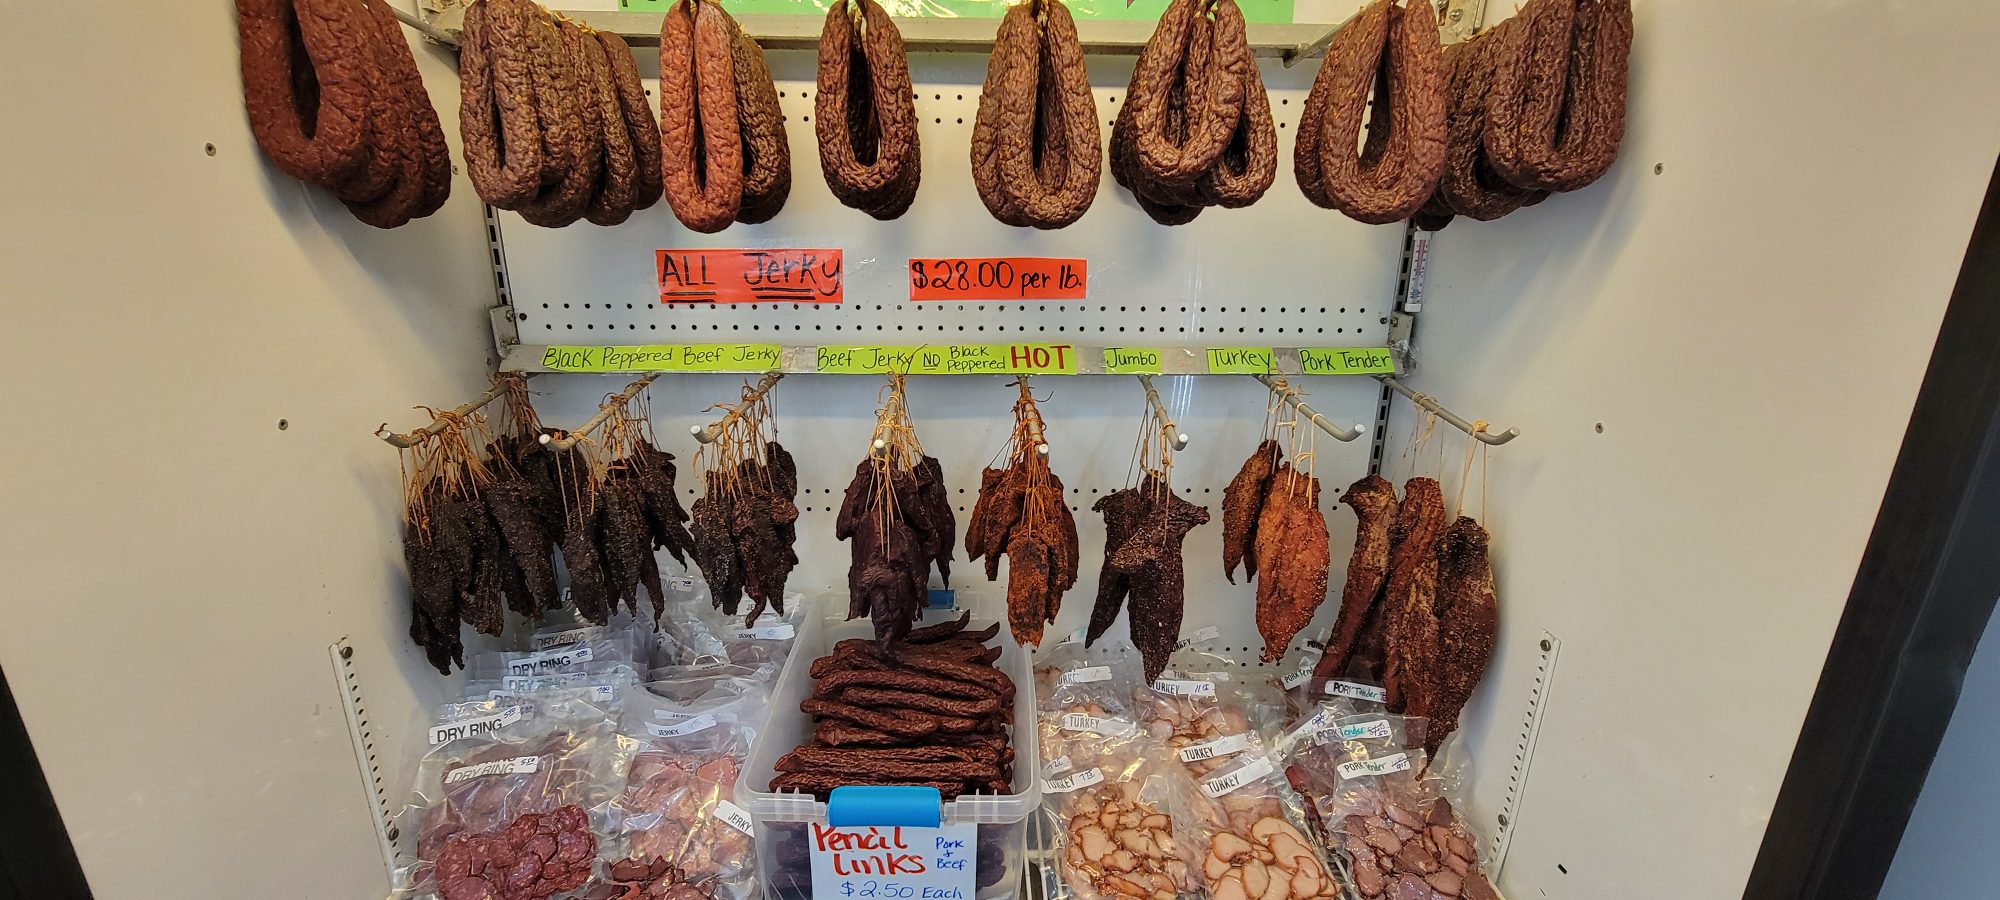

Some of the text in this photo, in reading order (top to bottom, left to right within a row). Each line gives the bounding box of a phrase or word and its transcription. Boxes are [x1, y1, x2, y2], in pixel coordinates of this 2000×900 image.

[661, 253, 715, 288] ALL
[911, 260, 1014, 291] $28.00
[1020, 271, 1051, 298] per
[542, 345, 781, 369] Black Peppered Beef Jerky
[817, 347, 856, 371] Beef
[923, 351, 941, 368] NO
[950, 345, 989, 359] Black
[1010, 345, 1071, 370] HOT
[1105, 347, 1157, 367] Jumbo
[1206, 348, 1271, 375] Turkey
[1300, 349, 1391, 371] Pork Tender
[947, 356, 1006, 372] Peppered
[437, 725, 466, 743] DRY
[470, 718, 502, 737] RING
[1070, 716, 1100, 729] TURKEY
[1184, 746, 1214, 760] TURKEY
[1344, 762, 1365, 773] PORK
[1046, 775, 1075, 790] TURKEY
[1207, 773, 1240, 794] TURKEY
[728, 812, 751, 832] JERKY
[812, 823, 908, 852] Pencil
[935, 836, 965, 849] Pork
[936, 857, 968, 870] Beef
[922, 886, 963, 900] Each
